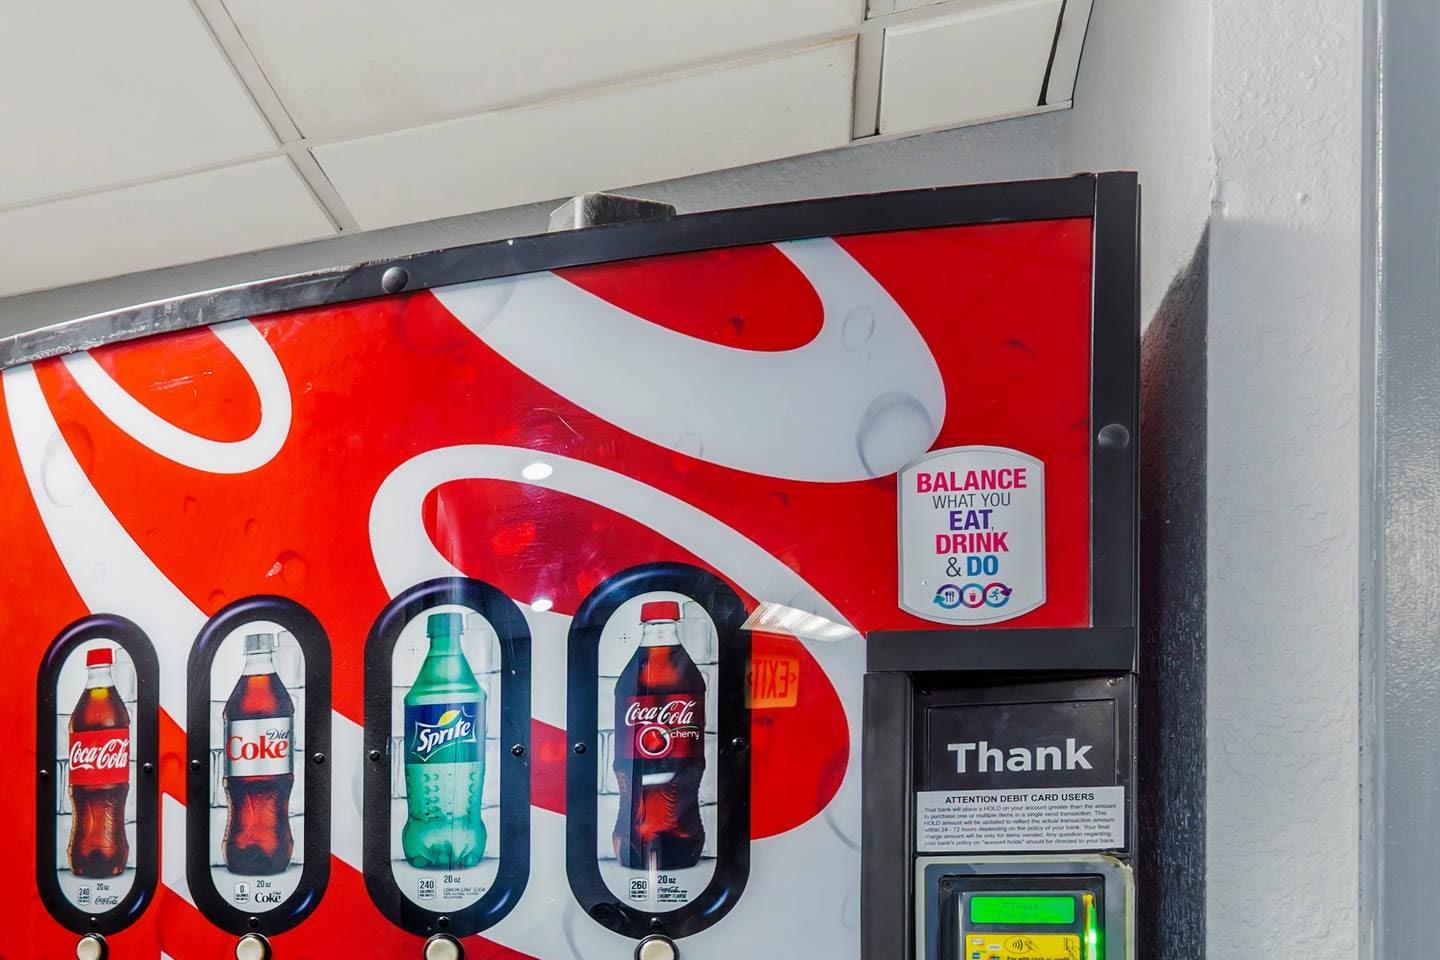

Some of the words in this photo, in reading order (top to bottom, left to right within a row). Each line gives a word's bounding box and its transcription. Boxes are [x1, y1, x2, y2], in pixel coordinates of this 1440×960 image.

[916, 468, 1027, 493] BALANCE
[933, 494, 976, 509] WHAT
[980, 492, 1011, 507] YOU
[949, 509, 994, 531] EAT,
[935, 532, 1009, 554] DRINK
[945, 556, 962, 577] &
[966, 554, 999, 577] DO
[625, 700, 696, 726] Coca-Cola
[416, 717, 471, 753] Sprite
[670, 729, 700, 741] cherry
[70, 738, 129, 770] Coca-Cola
[225, 735, 289, 761] Coke
[947, 738, 1093, 773] Thank
[945, 796, 998, 804] ATTENTION
[1000, 794, 1028, 803] DEBIT
[1031, 793, 1059, 802] CARD
[1061, 792, 1095, 801] USERS
[256, 879, 265, 888] 20
[420, 880, 434, 889] 240
[443, 874, 453, 884] 20
[631, 880, 647, 890] 260
[657, 874, 668, 884] 20
[79, 887, 90, 896] 240
[96, 883, 104, 891] 20
[255, 892, 281, 903] Coke
